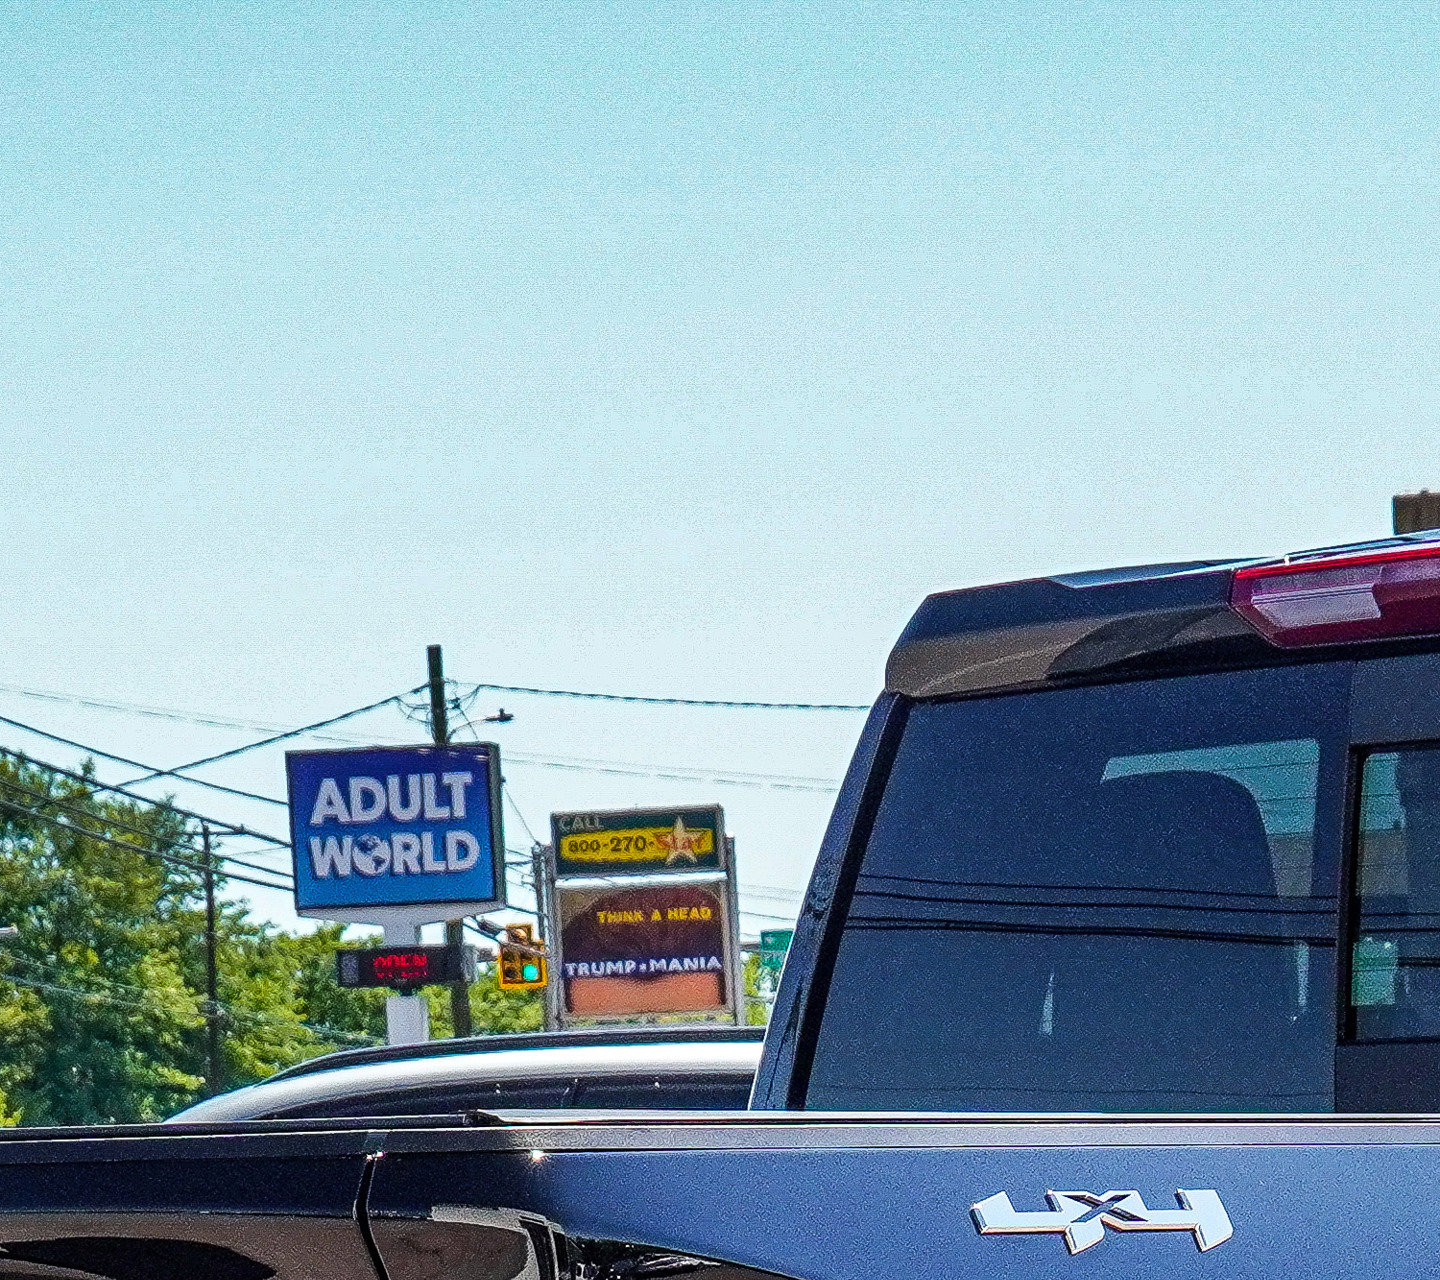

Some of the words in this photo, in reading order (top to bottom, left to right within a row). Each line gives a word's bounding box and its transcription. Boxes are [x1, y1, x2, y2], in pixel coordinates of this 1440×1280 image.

[309, 771, 474, 825] ADULT
[560, 816, 604, 831] CALL
[309, 829, 480, 879] WORLD
[597, 910, 643, 924] THINK
[651, 909, 662, 921] A
[668, 907, 712, 921] HEAD
